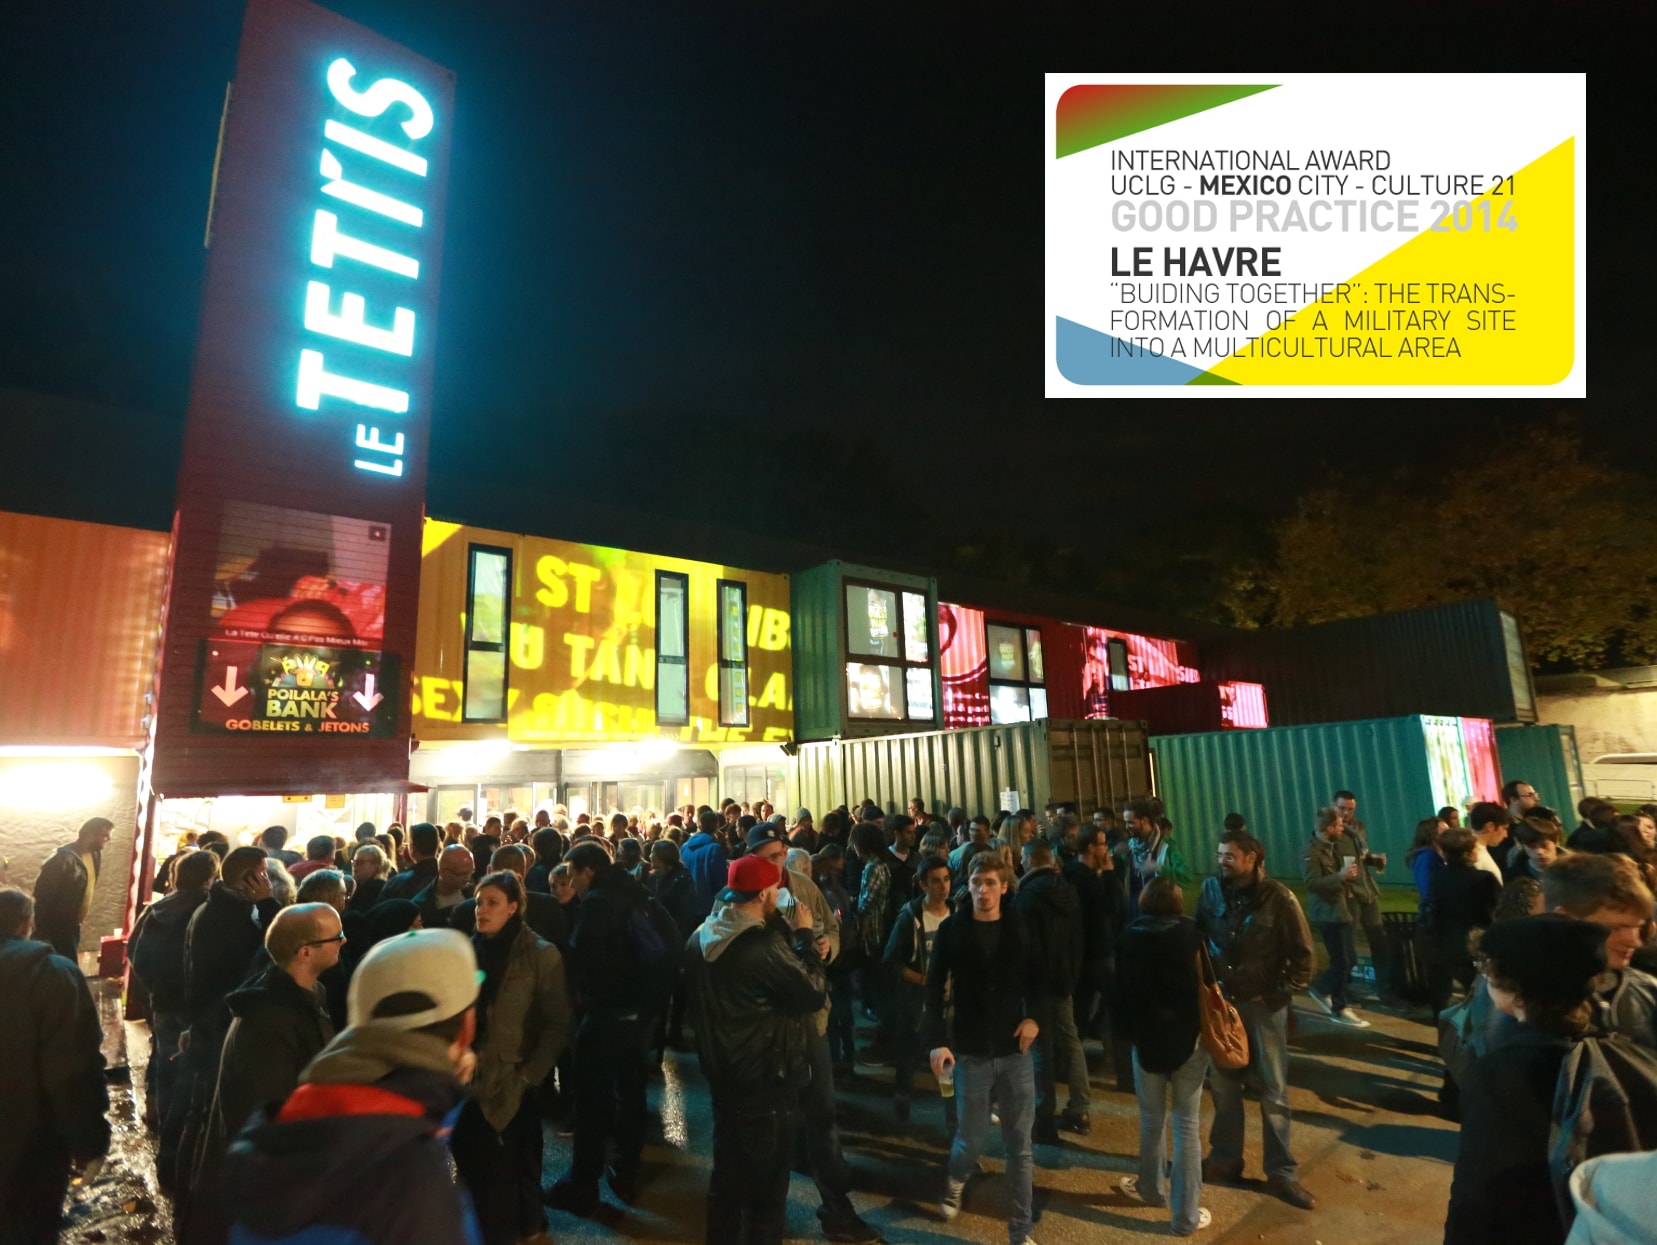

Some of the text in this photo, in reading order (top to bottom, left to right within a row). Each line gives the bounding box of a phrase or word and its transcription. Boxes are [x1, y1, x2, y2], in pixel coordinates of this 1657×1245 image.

[353, 423, 406, 477] LE
[266, 688, 340, 702] POILALA'S
[265, 700, 338, 719] BANK
[225, 718, 371, 733] GOBELETS & JETONS
